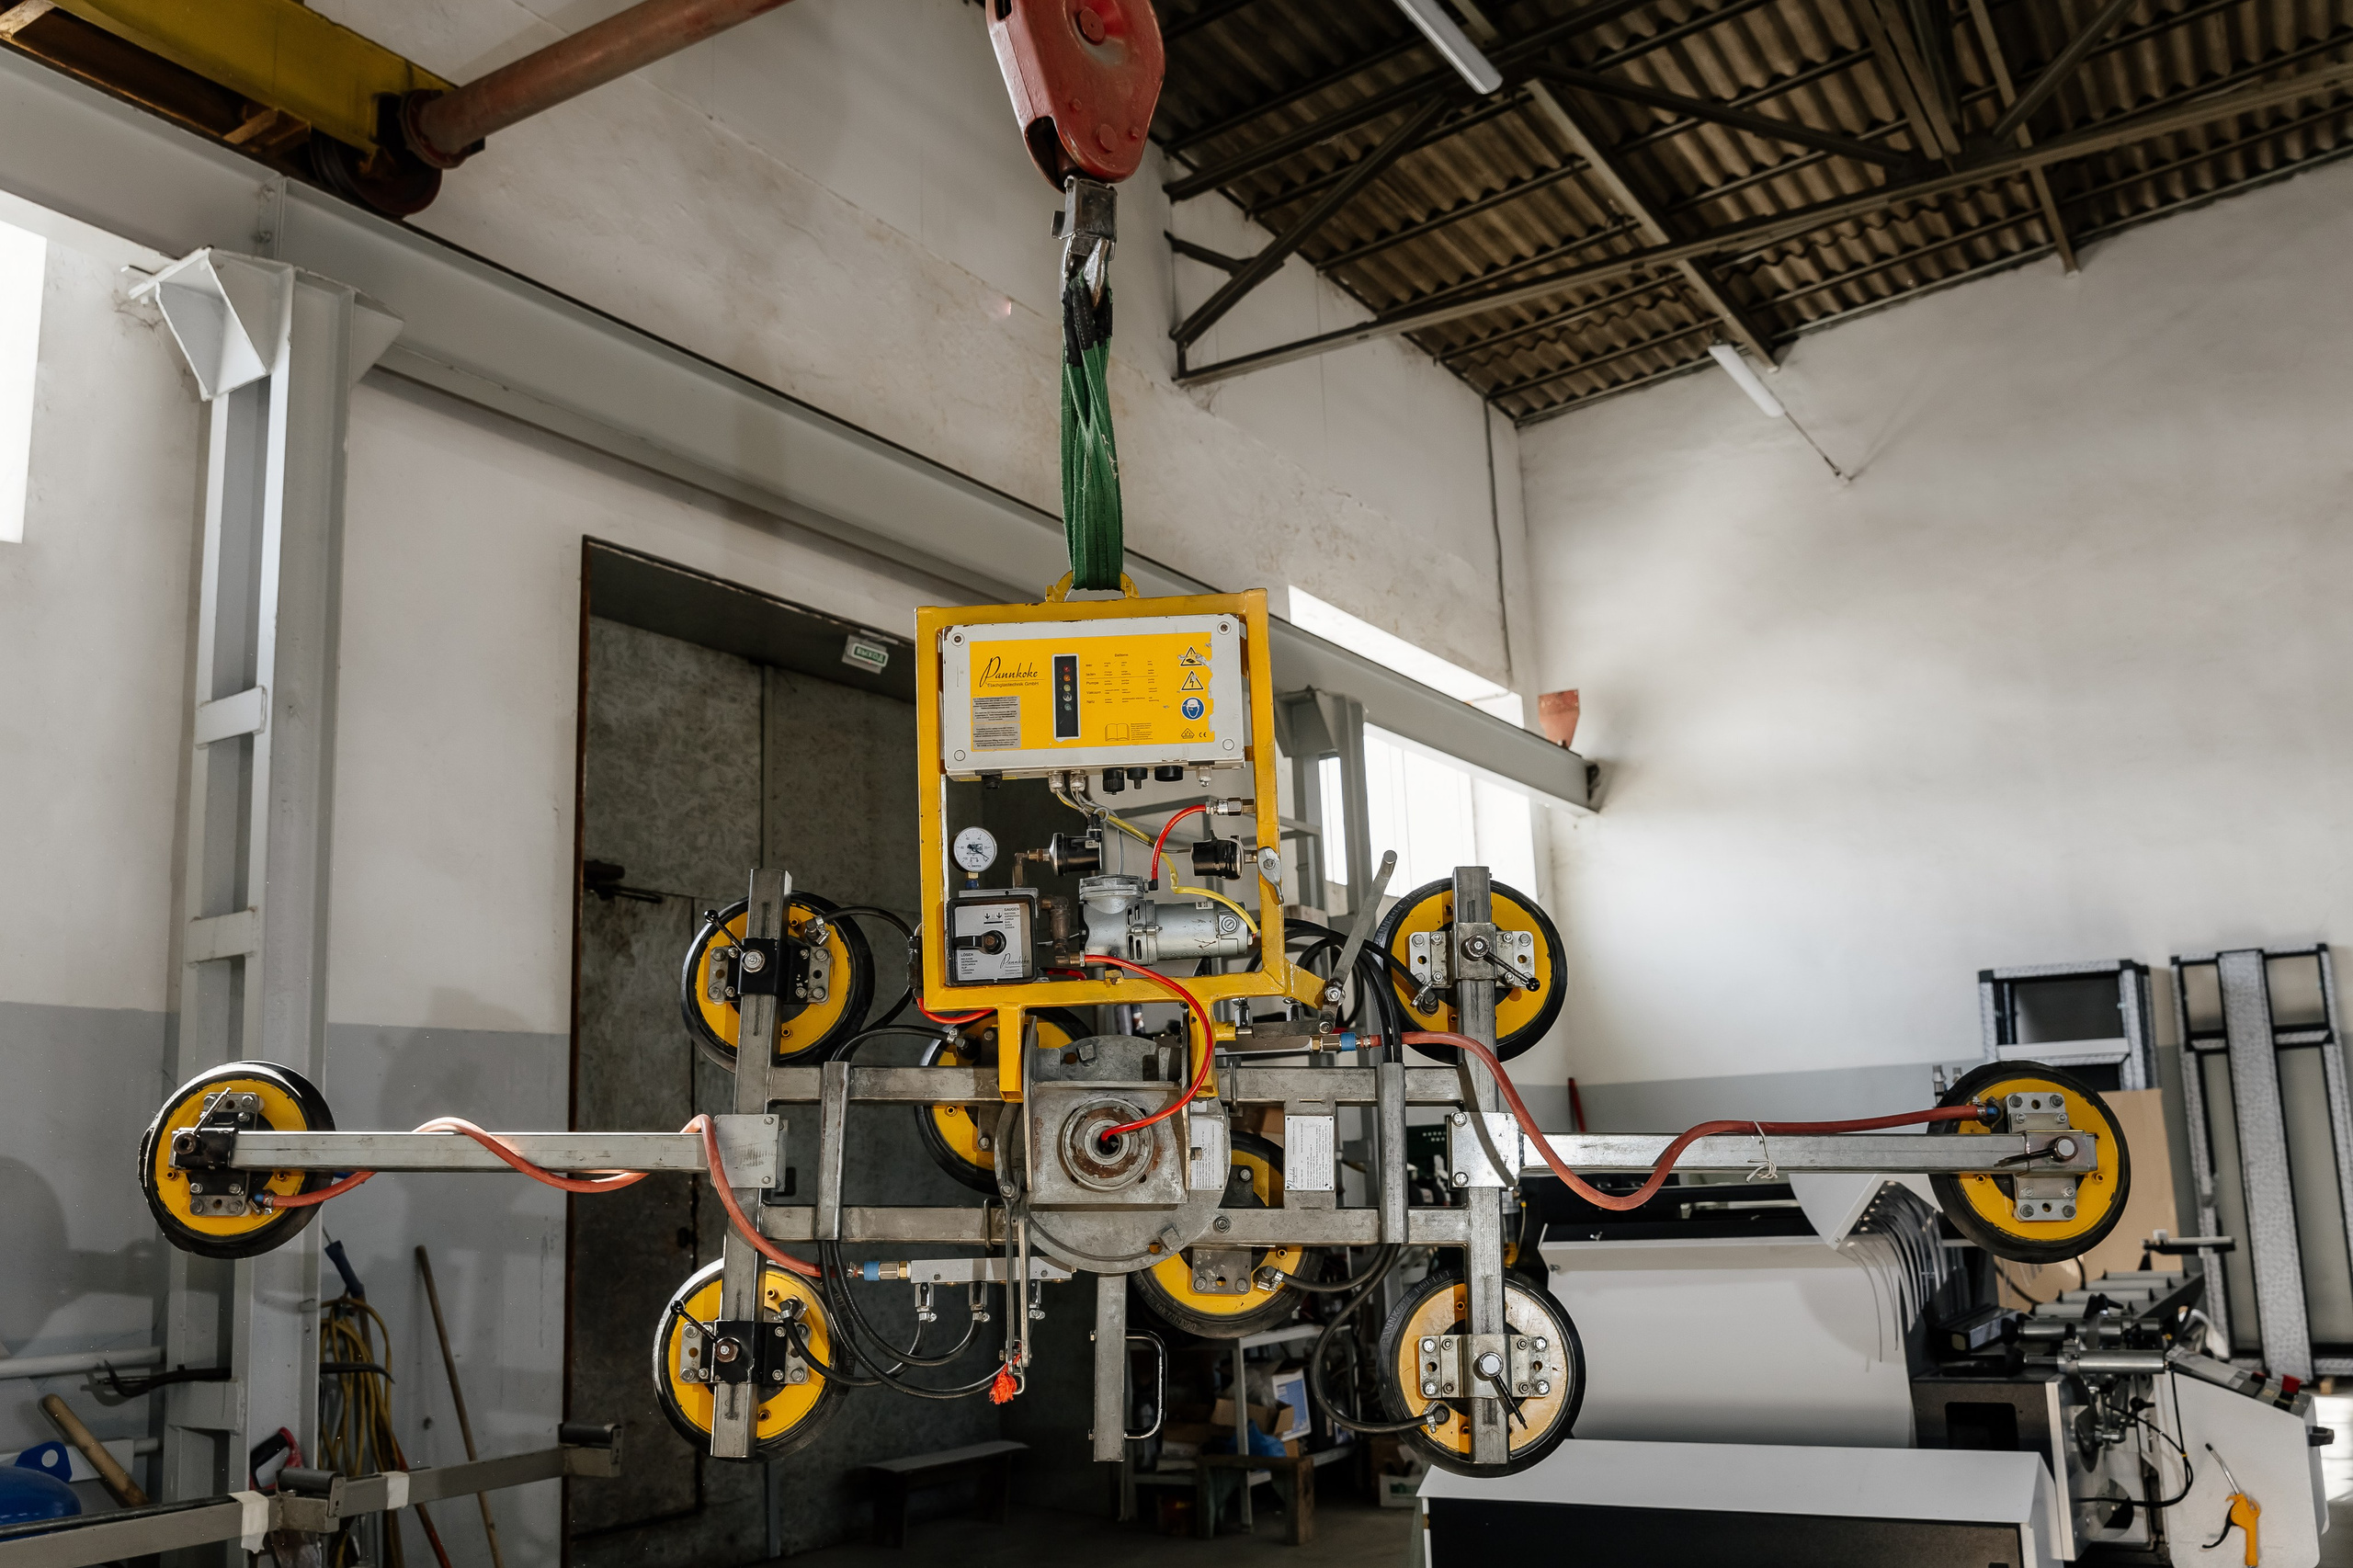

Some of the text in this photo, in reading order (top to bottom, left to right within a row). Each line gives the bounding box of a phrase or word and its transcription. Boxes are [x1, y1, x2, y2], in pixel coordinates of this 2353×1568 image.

[979, 655, 1039, 687] Pannkoke
[999, 952, 1029, 969] Pannkoke
[1381, 1293, 1416, 1346] PANNKOKE
